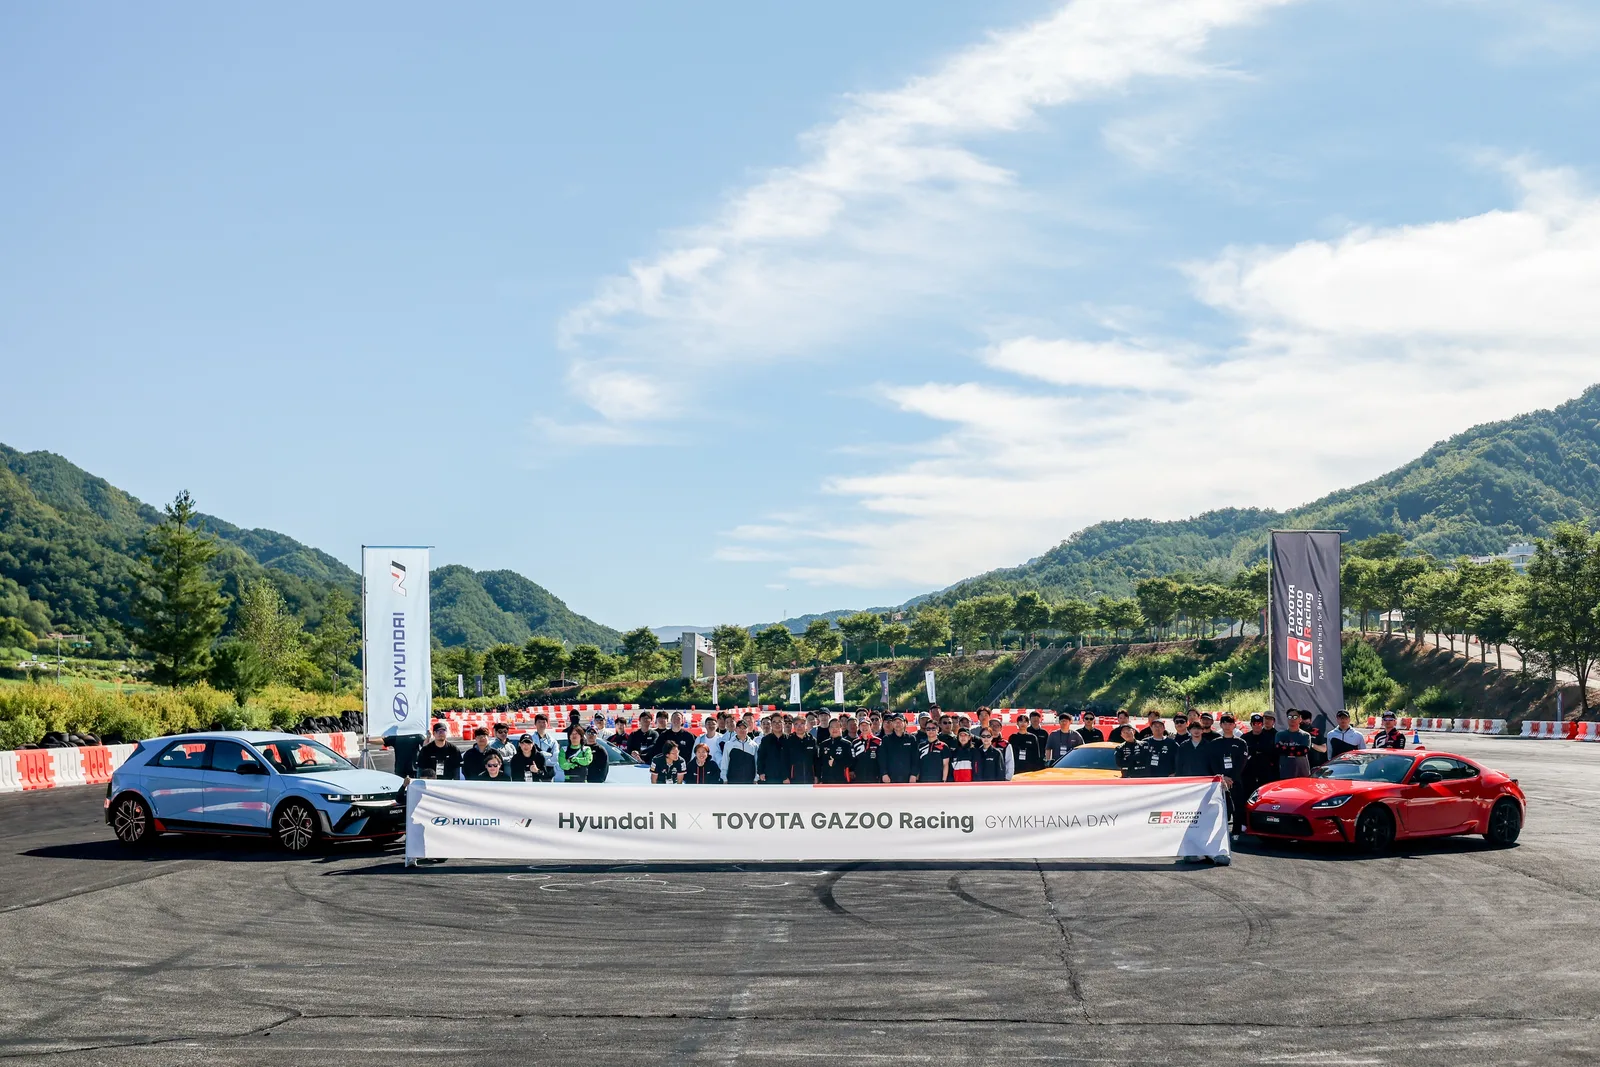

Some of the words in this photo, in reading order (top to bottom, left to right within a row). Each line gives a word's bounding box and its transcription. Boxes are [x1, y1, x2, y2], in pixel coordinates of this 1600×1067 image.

[1304, 592, 1313, 638] Racing
[392, 612, 406, 688] HYUNDAI
[1297, 641, 1312, 683] GR
[452, 817, 500, 826] HYUNDAI
[558, 811, 654, 833] Hyundai
[660, 812, 677, 829] N
[712, 812, 805, 830] TOYOTA
[810, 812, 893, 829] GAZOO
[899, 811, 974, 833] Racing
[984, 815, 1082, 829] GYMKHANA
[1087, 814, 1119, 828] DAY
